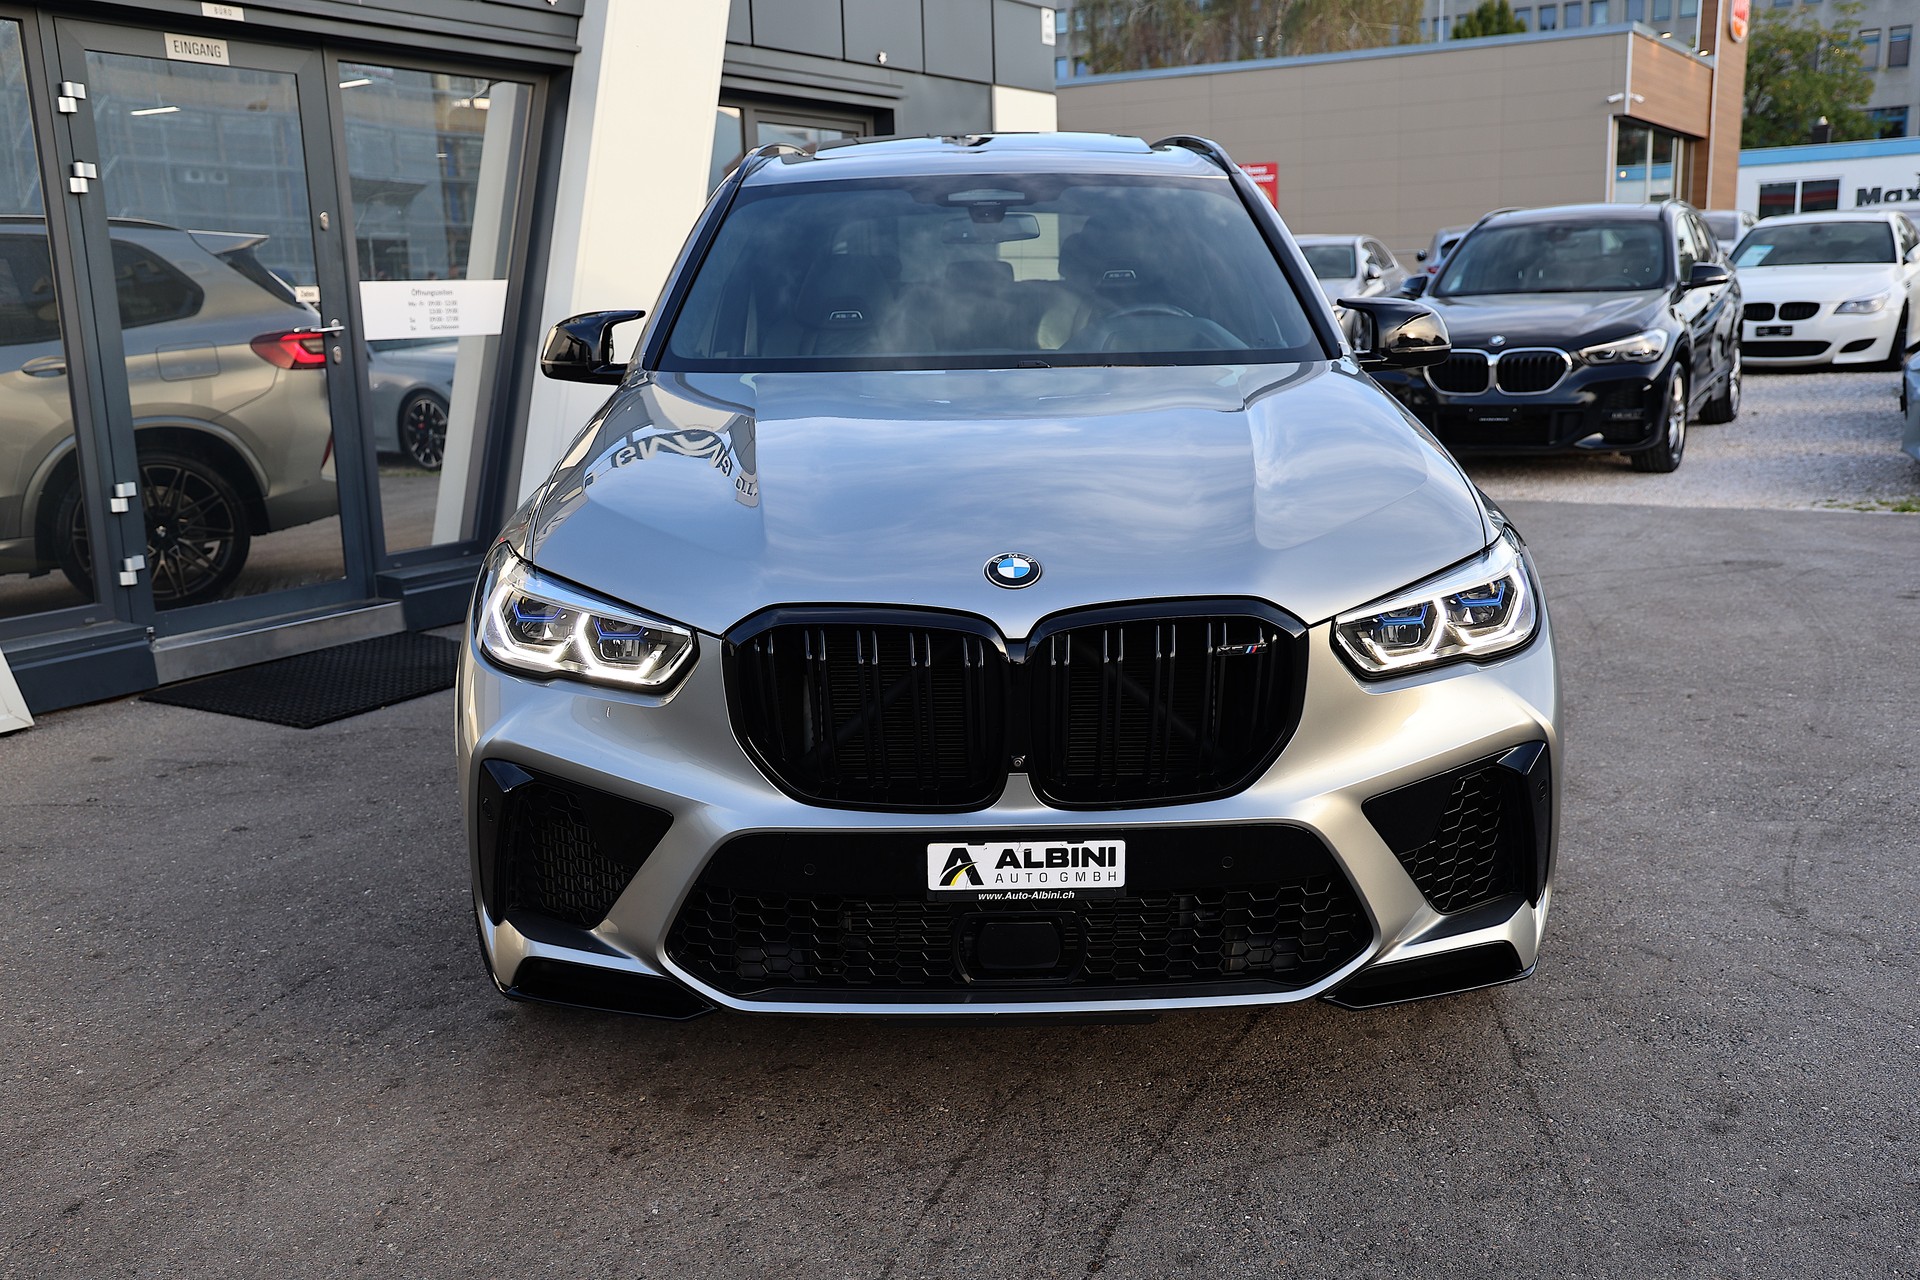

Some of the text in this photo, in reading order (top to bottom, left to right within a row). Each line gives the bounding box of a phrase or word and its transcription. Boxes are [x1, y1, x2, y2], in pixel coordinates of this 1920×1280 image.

[173, 40, 222, 58] EINGANG
[992, 553, 1035, 563] BMW
[995, 846, 1117, 870] ALBINI
[995, 871, 1117, 884] AUTO GMBH
[978, 889, 1075, 901] www.Auto-Albini.ch
